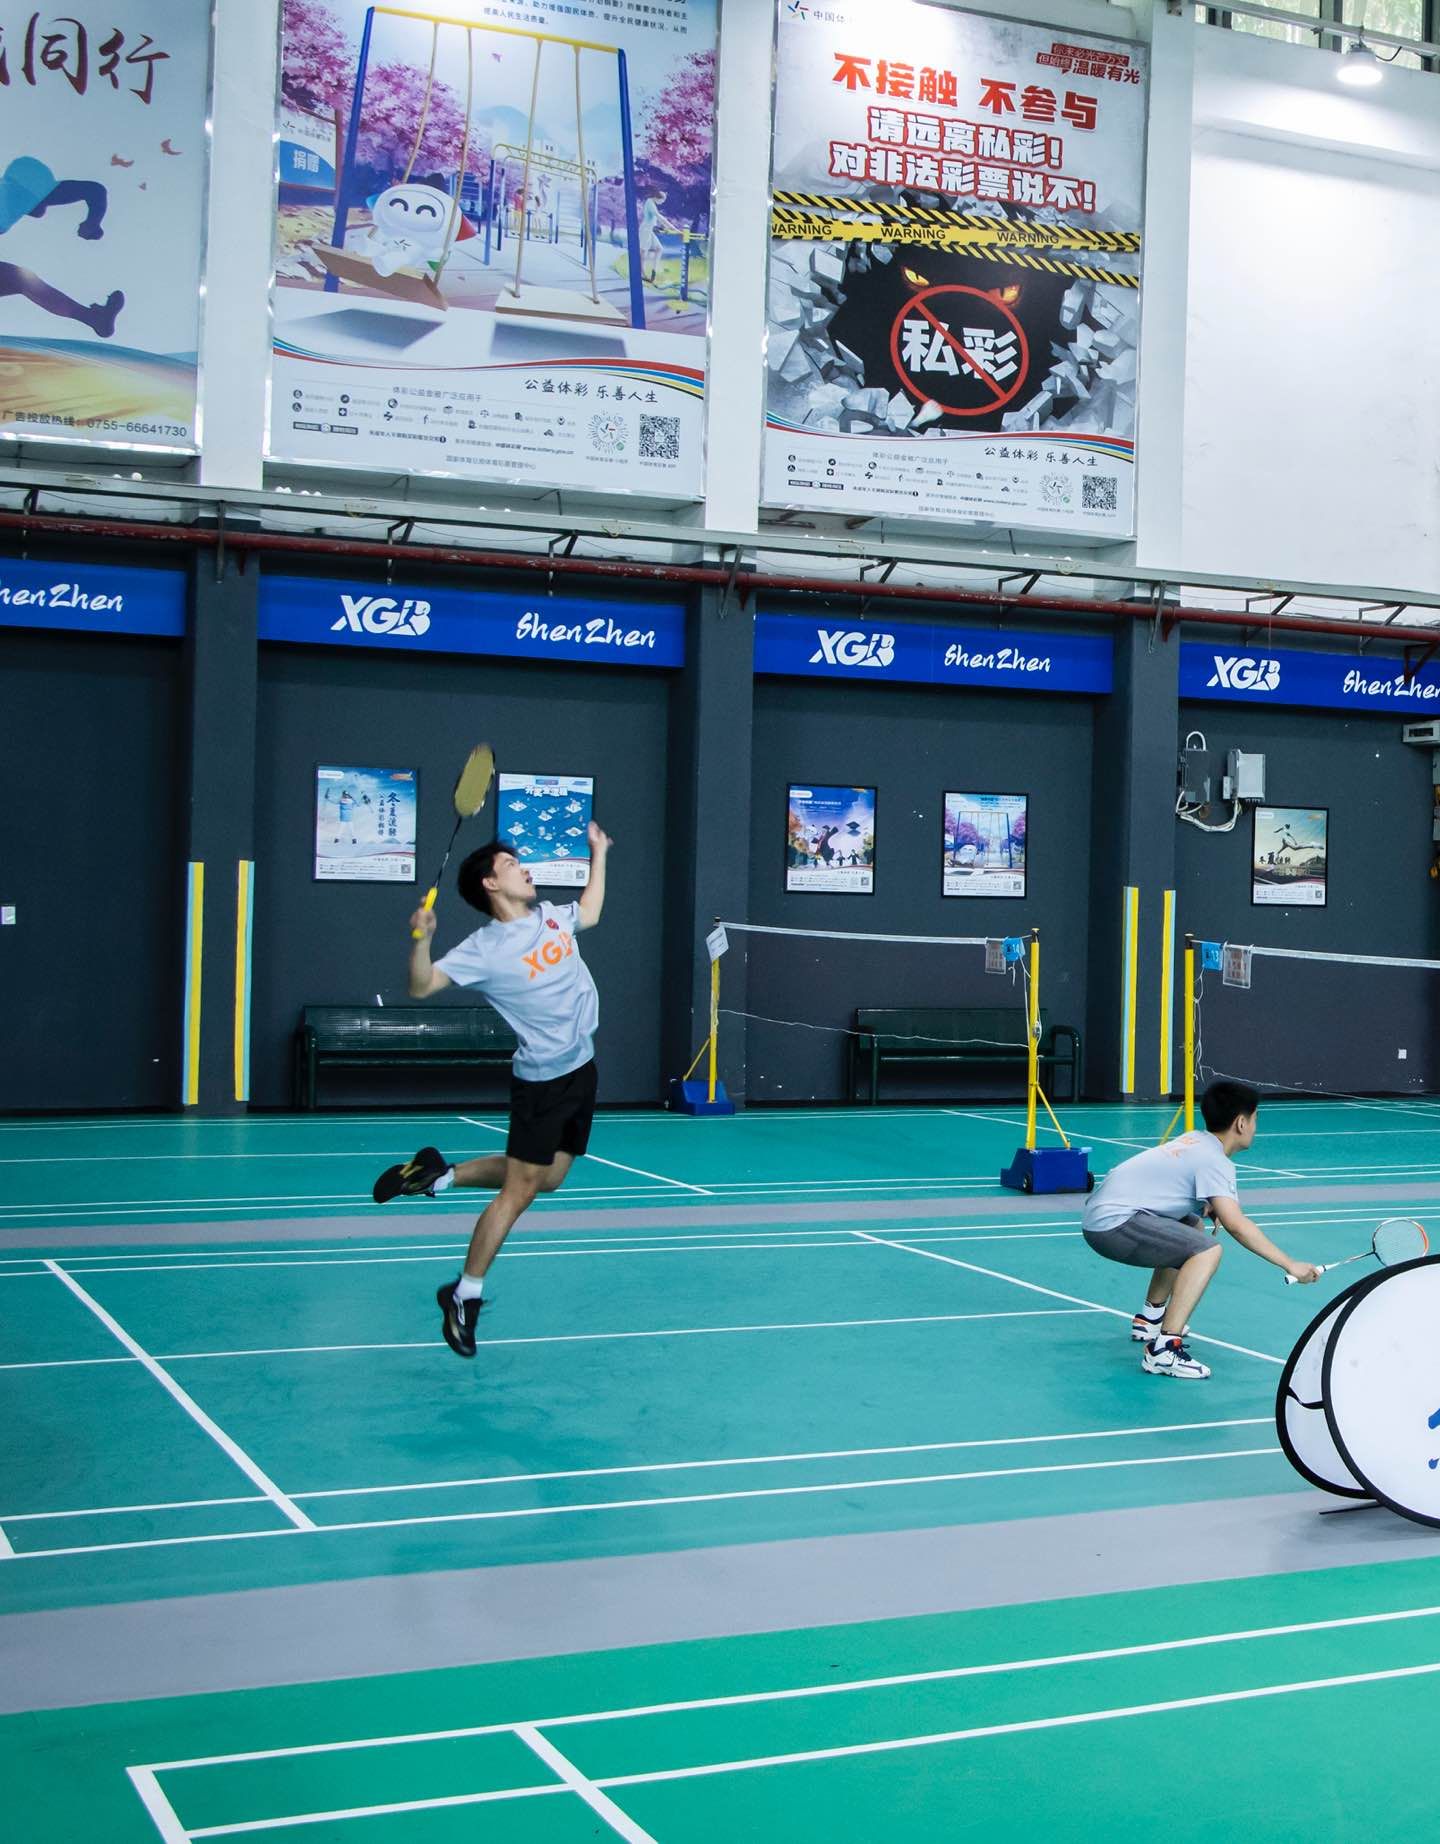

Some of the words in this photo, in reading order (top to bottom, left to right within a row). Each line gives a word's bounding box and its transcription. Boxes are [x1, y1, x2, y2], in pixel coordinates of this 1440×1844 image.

[0, 12, 170, 104] 同行
[1073, 60, 1140, 84] 温暖有光
[832, 52, 958, 107] 不接触
[978, 77, 1098, 130] 不参与
[881, 227, 946, 239] WARNING
[997, 231, 1060, 244] WARNING
[902, 319, 1018, 381] 私彩
[525, 378, 588, 397] 公益体彩
[597, 385, 658, 403] 乐善人生
[984, 447, 1039, 461] 公益体彩
[1045, 452, 1098, 467] 乐善人生
[331, 594, 431, 636] XGB
[809, 629, 895, 667] XGB
[1206, 655, 1281, 691] XGB
